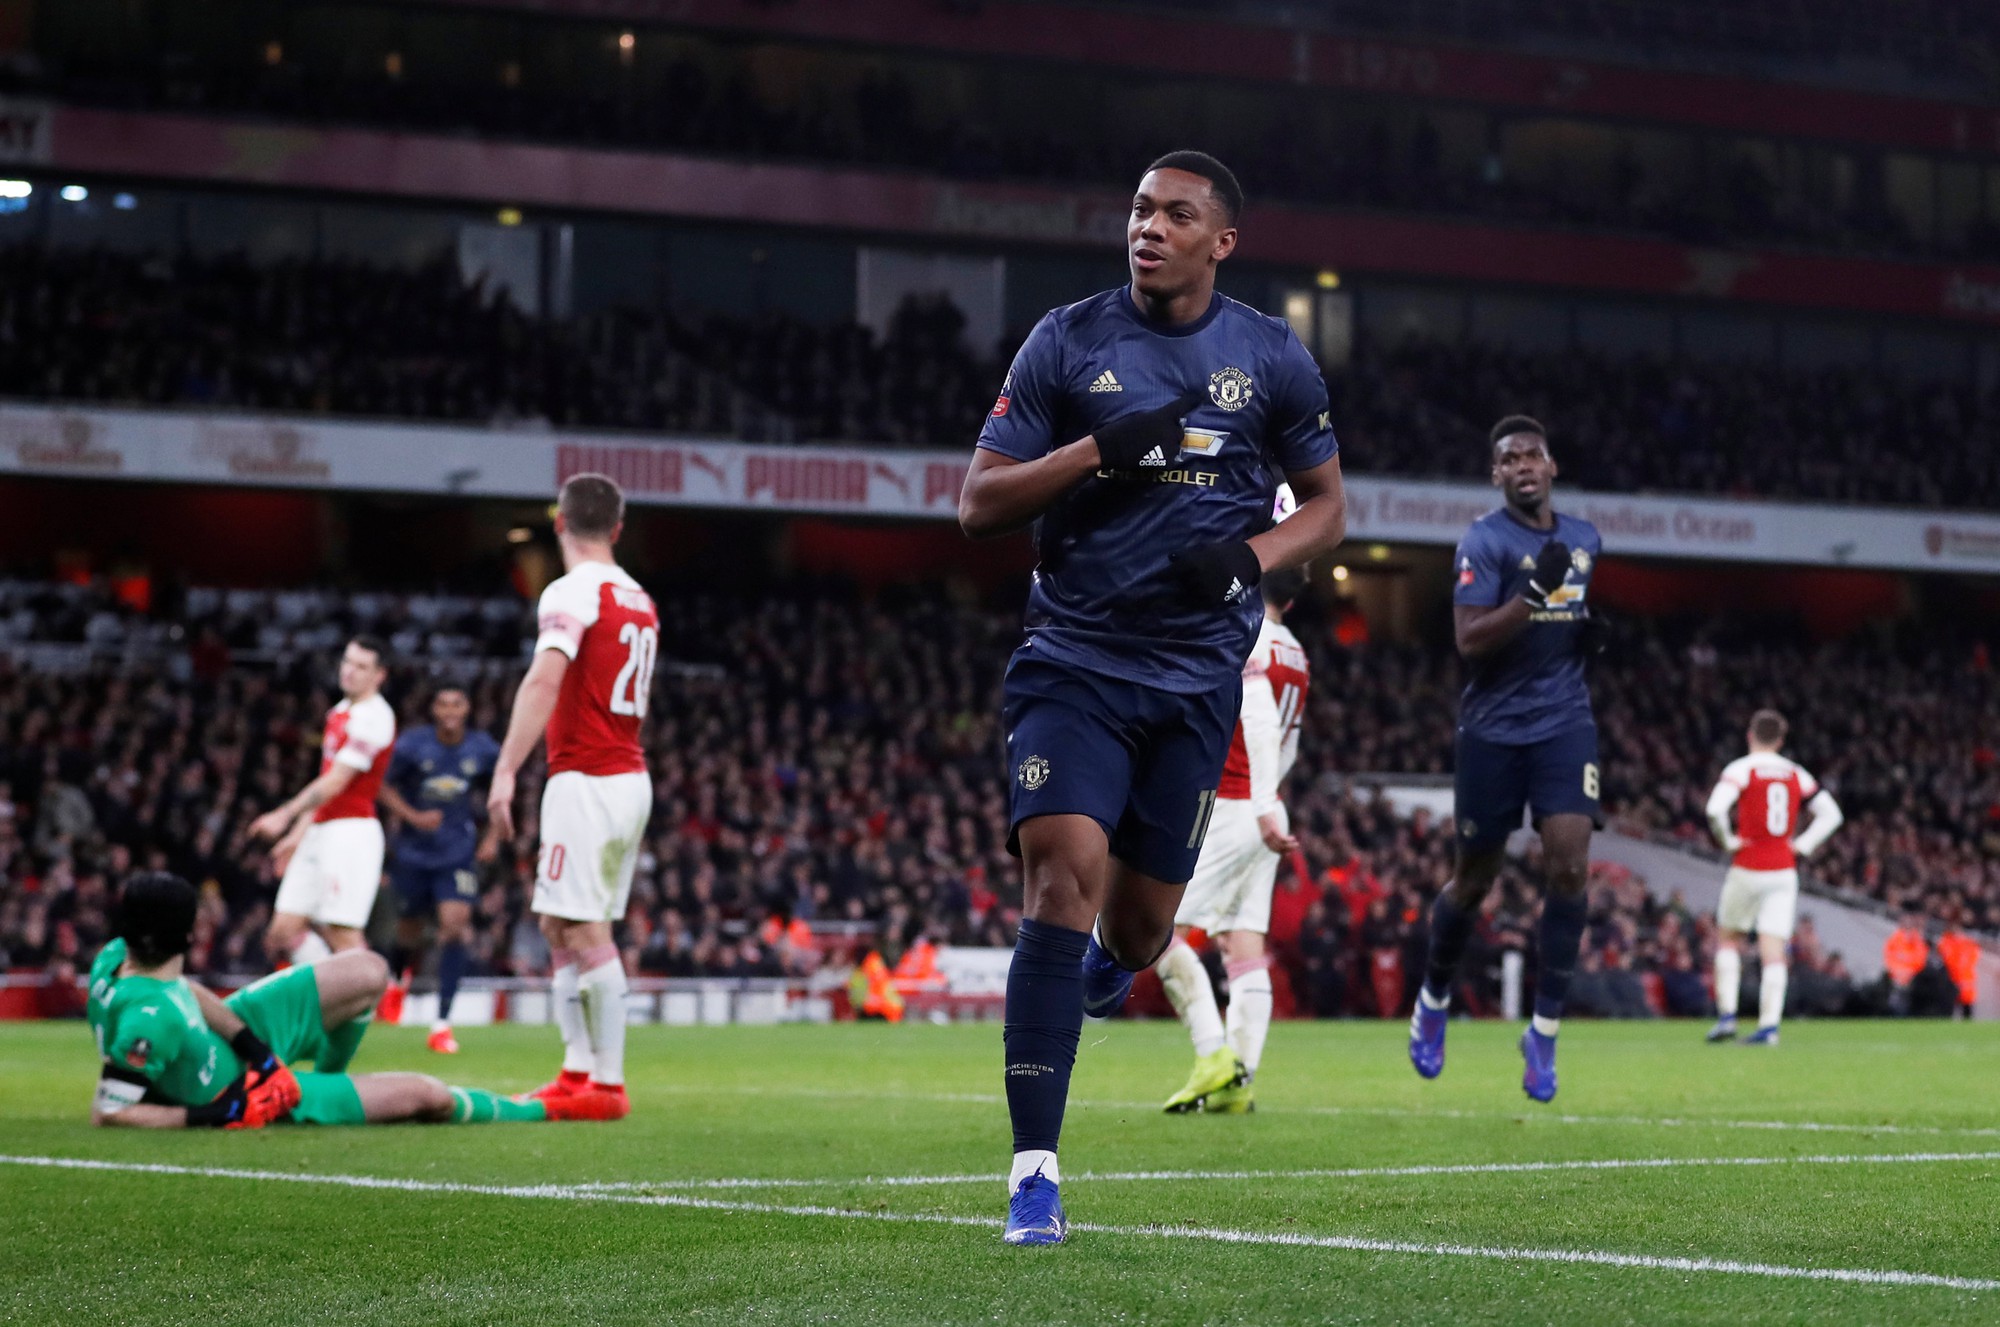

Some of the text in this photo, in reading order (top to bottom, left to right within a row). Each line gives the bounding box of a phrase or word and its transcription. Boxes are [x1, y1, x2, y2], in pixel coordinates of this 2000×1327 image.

[1089, 383, 1122, 392] adidas
[1217, 399, 1243, 409] UNITED
[747, 456, 868, 504] PUMA
[1096, 468, 1219, 487] CHEROLET
[1139, 459, 1167, 467] adidas
[610, 622, 657, 718] 20
[1584, 762, 1600, 800] 6
[1186, 789, 1217, 849] 11
[1767, 782, 1790, 837] 8
[540, 843, 566, 881] 0
